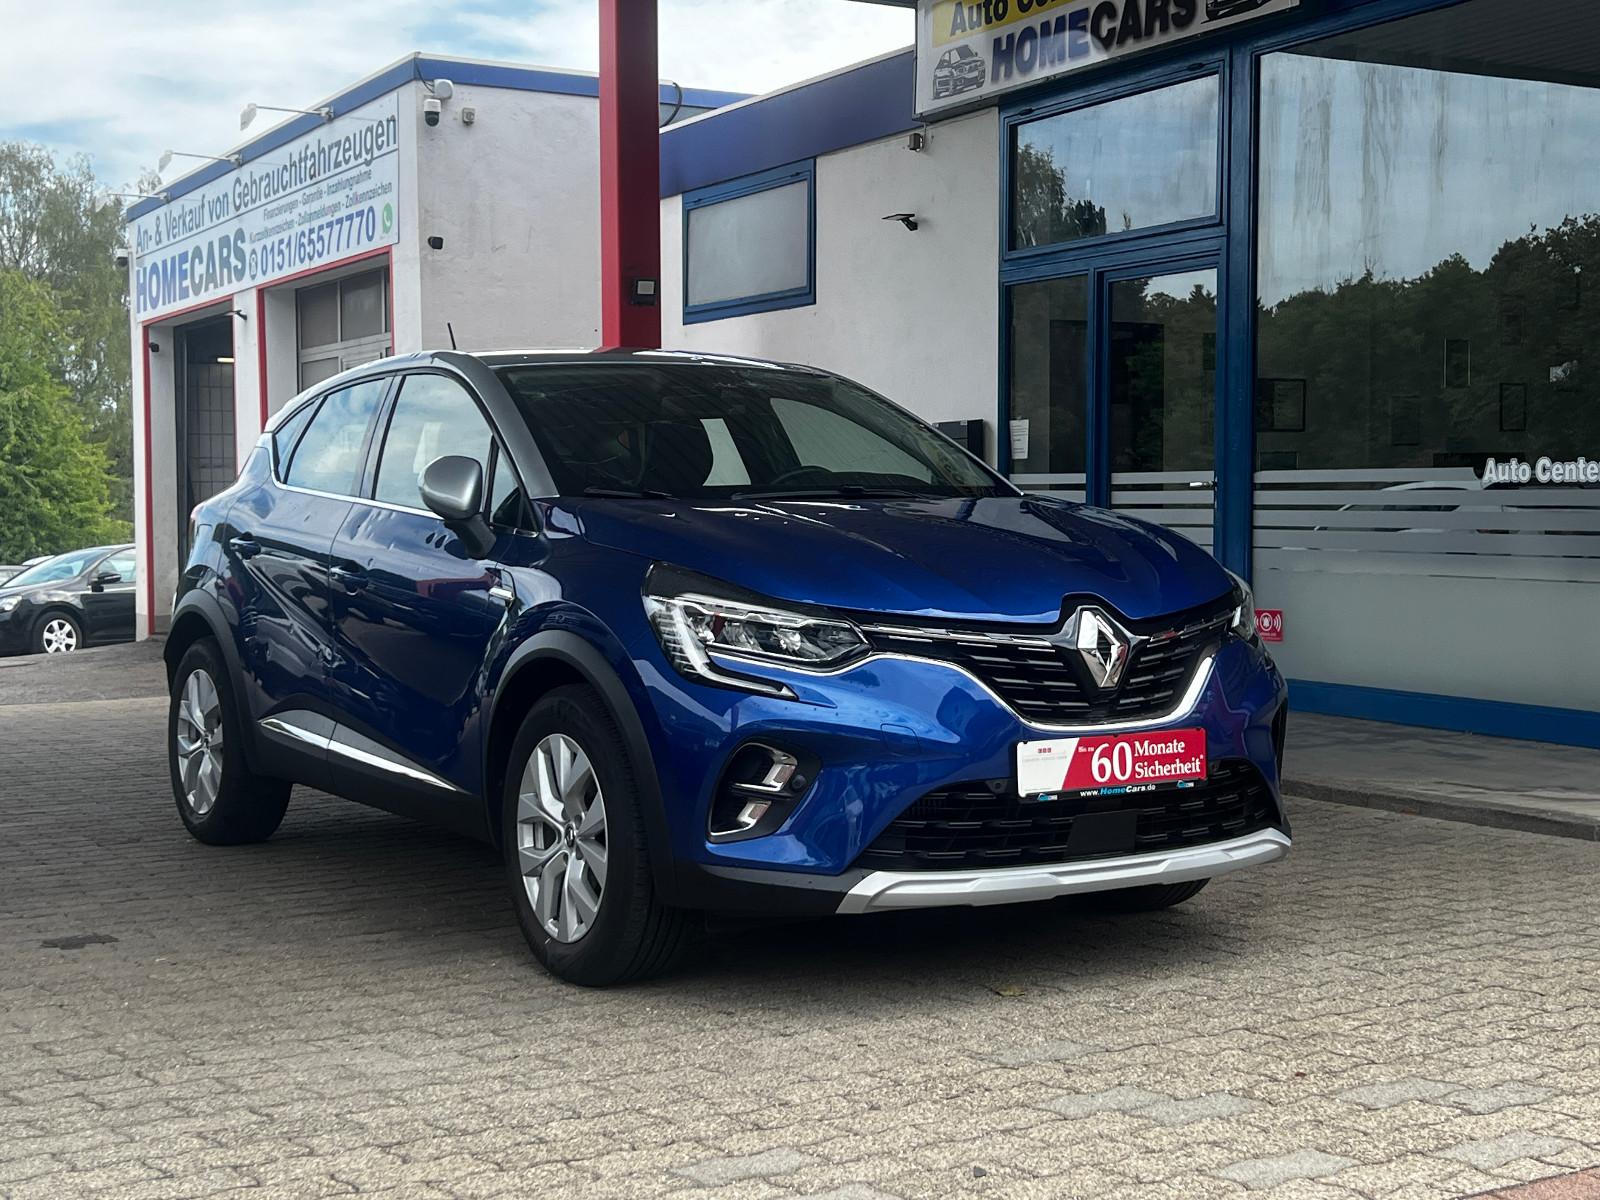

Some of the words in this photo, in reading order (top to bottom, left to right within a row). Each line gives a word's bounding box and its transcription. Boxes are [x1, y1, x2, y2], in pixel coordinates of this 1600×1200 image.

[950, 0, 1009, 36] Auto
[991, 0, 1197, 84] HOMECARS
[136, 225, 153, 254] An-
[155, 216, 163, 246] &
[165, 194, 206, 241] Verkauf
[208, 191, 229, 223] von
[233, 114, 397, 212] Gebrauchtfahrzeugen
[261, 205, 376, 276] 0151/65577770
[136, 227, 246, 314] HOMECARS
[1482, 457, 1531, 482] Auto
[1535, 456, 1600, 483] Cente
[1091, 742, 1132, 783] 60
[1134, 739, 1185, 756] Monate
